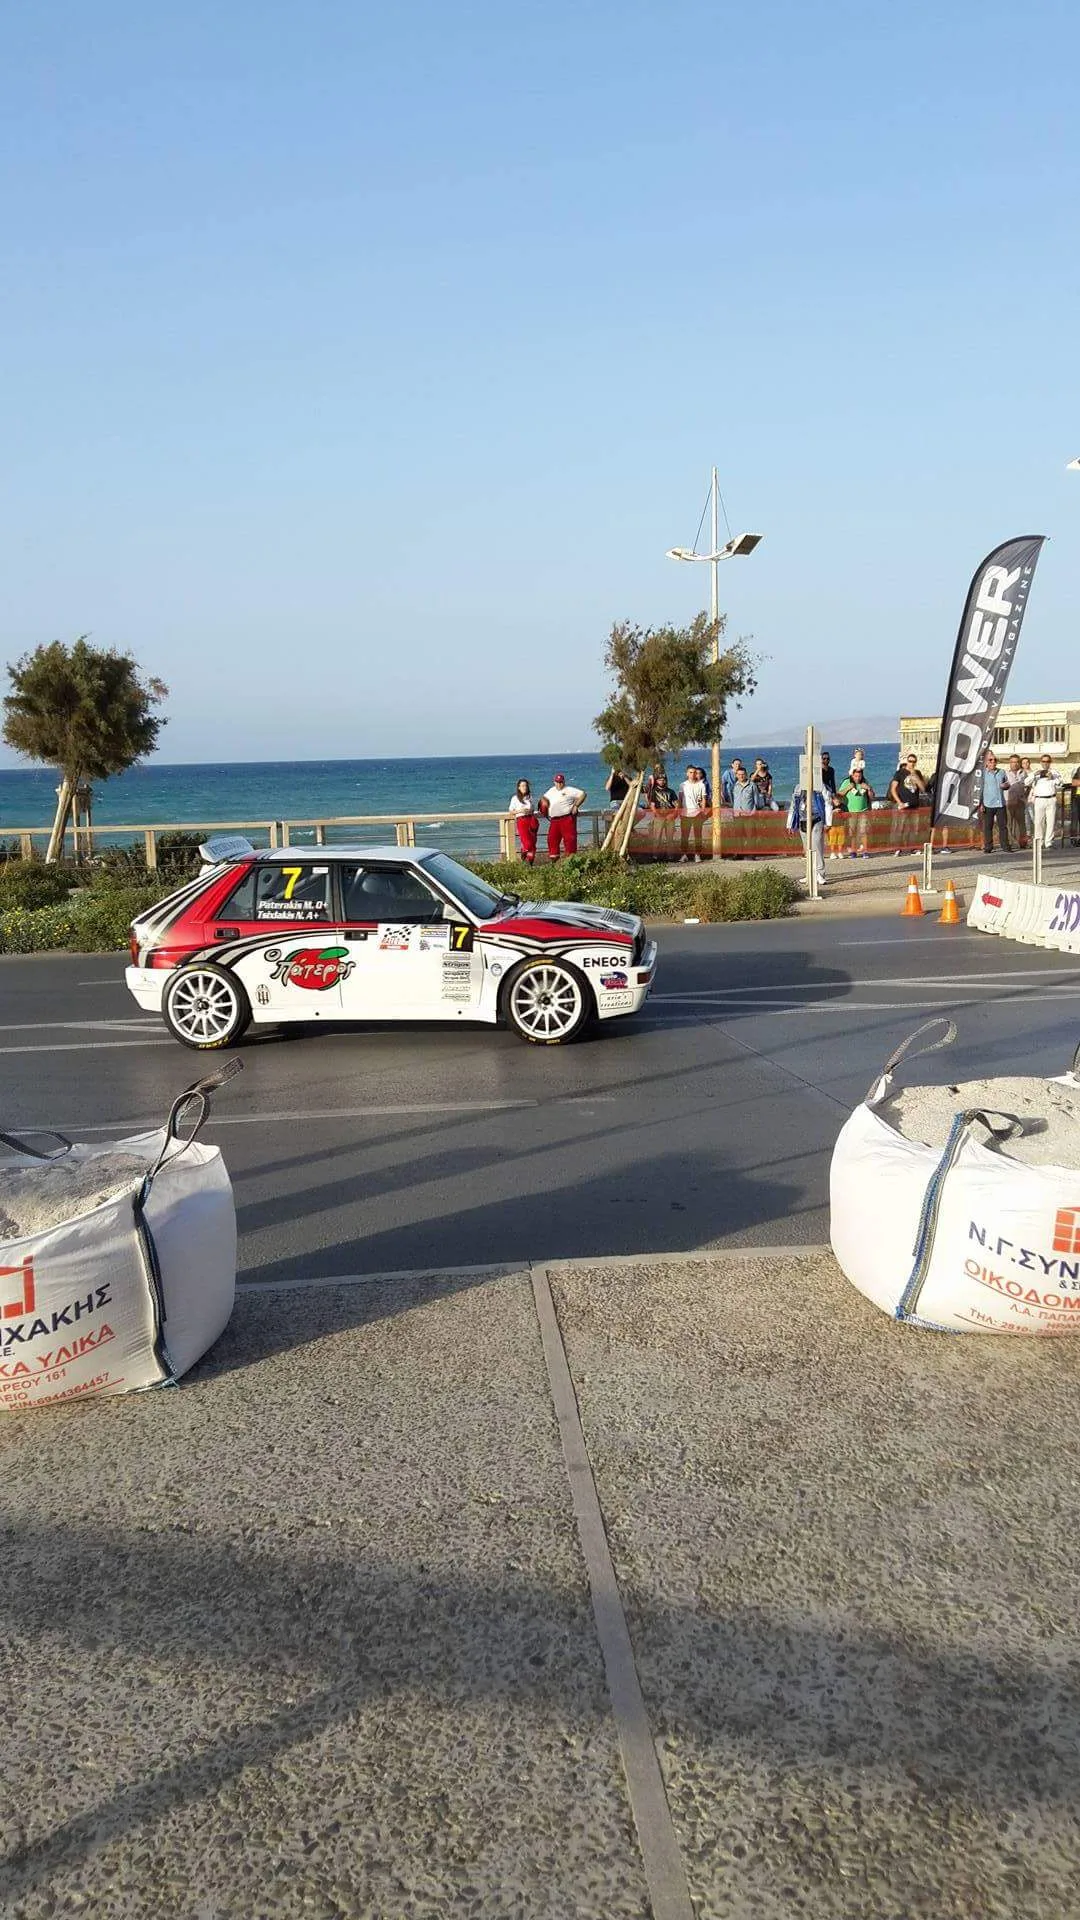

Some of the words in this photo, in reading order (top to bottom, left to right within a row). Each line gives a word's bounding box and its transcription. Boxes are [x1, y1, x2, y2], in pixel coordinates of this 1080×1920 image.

[1001, 566, 1032, 671] MAGAZINE
[940, 565, 1021, 821] POWER
[282, 867, 302, 900] 7
[454, 926, 470, 949] 7
[583, 956, 628, 968] ENEOS
[36, 1323, 114, 1369] ΥΛΙΚΑ
[46, 1368, 66, 1384] 161
